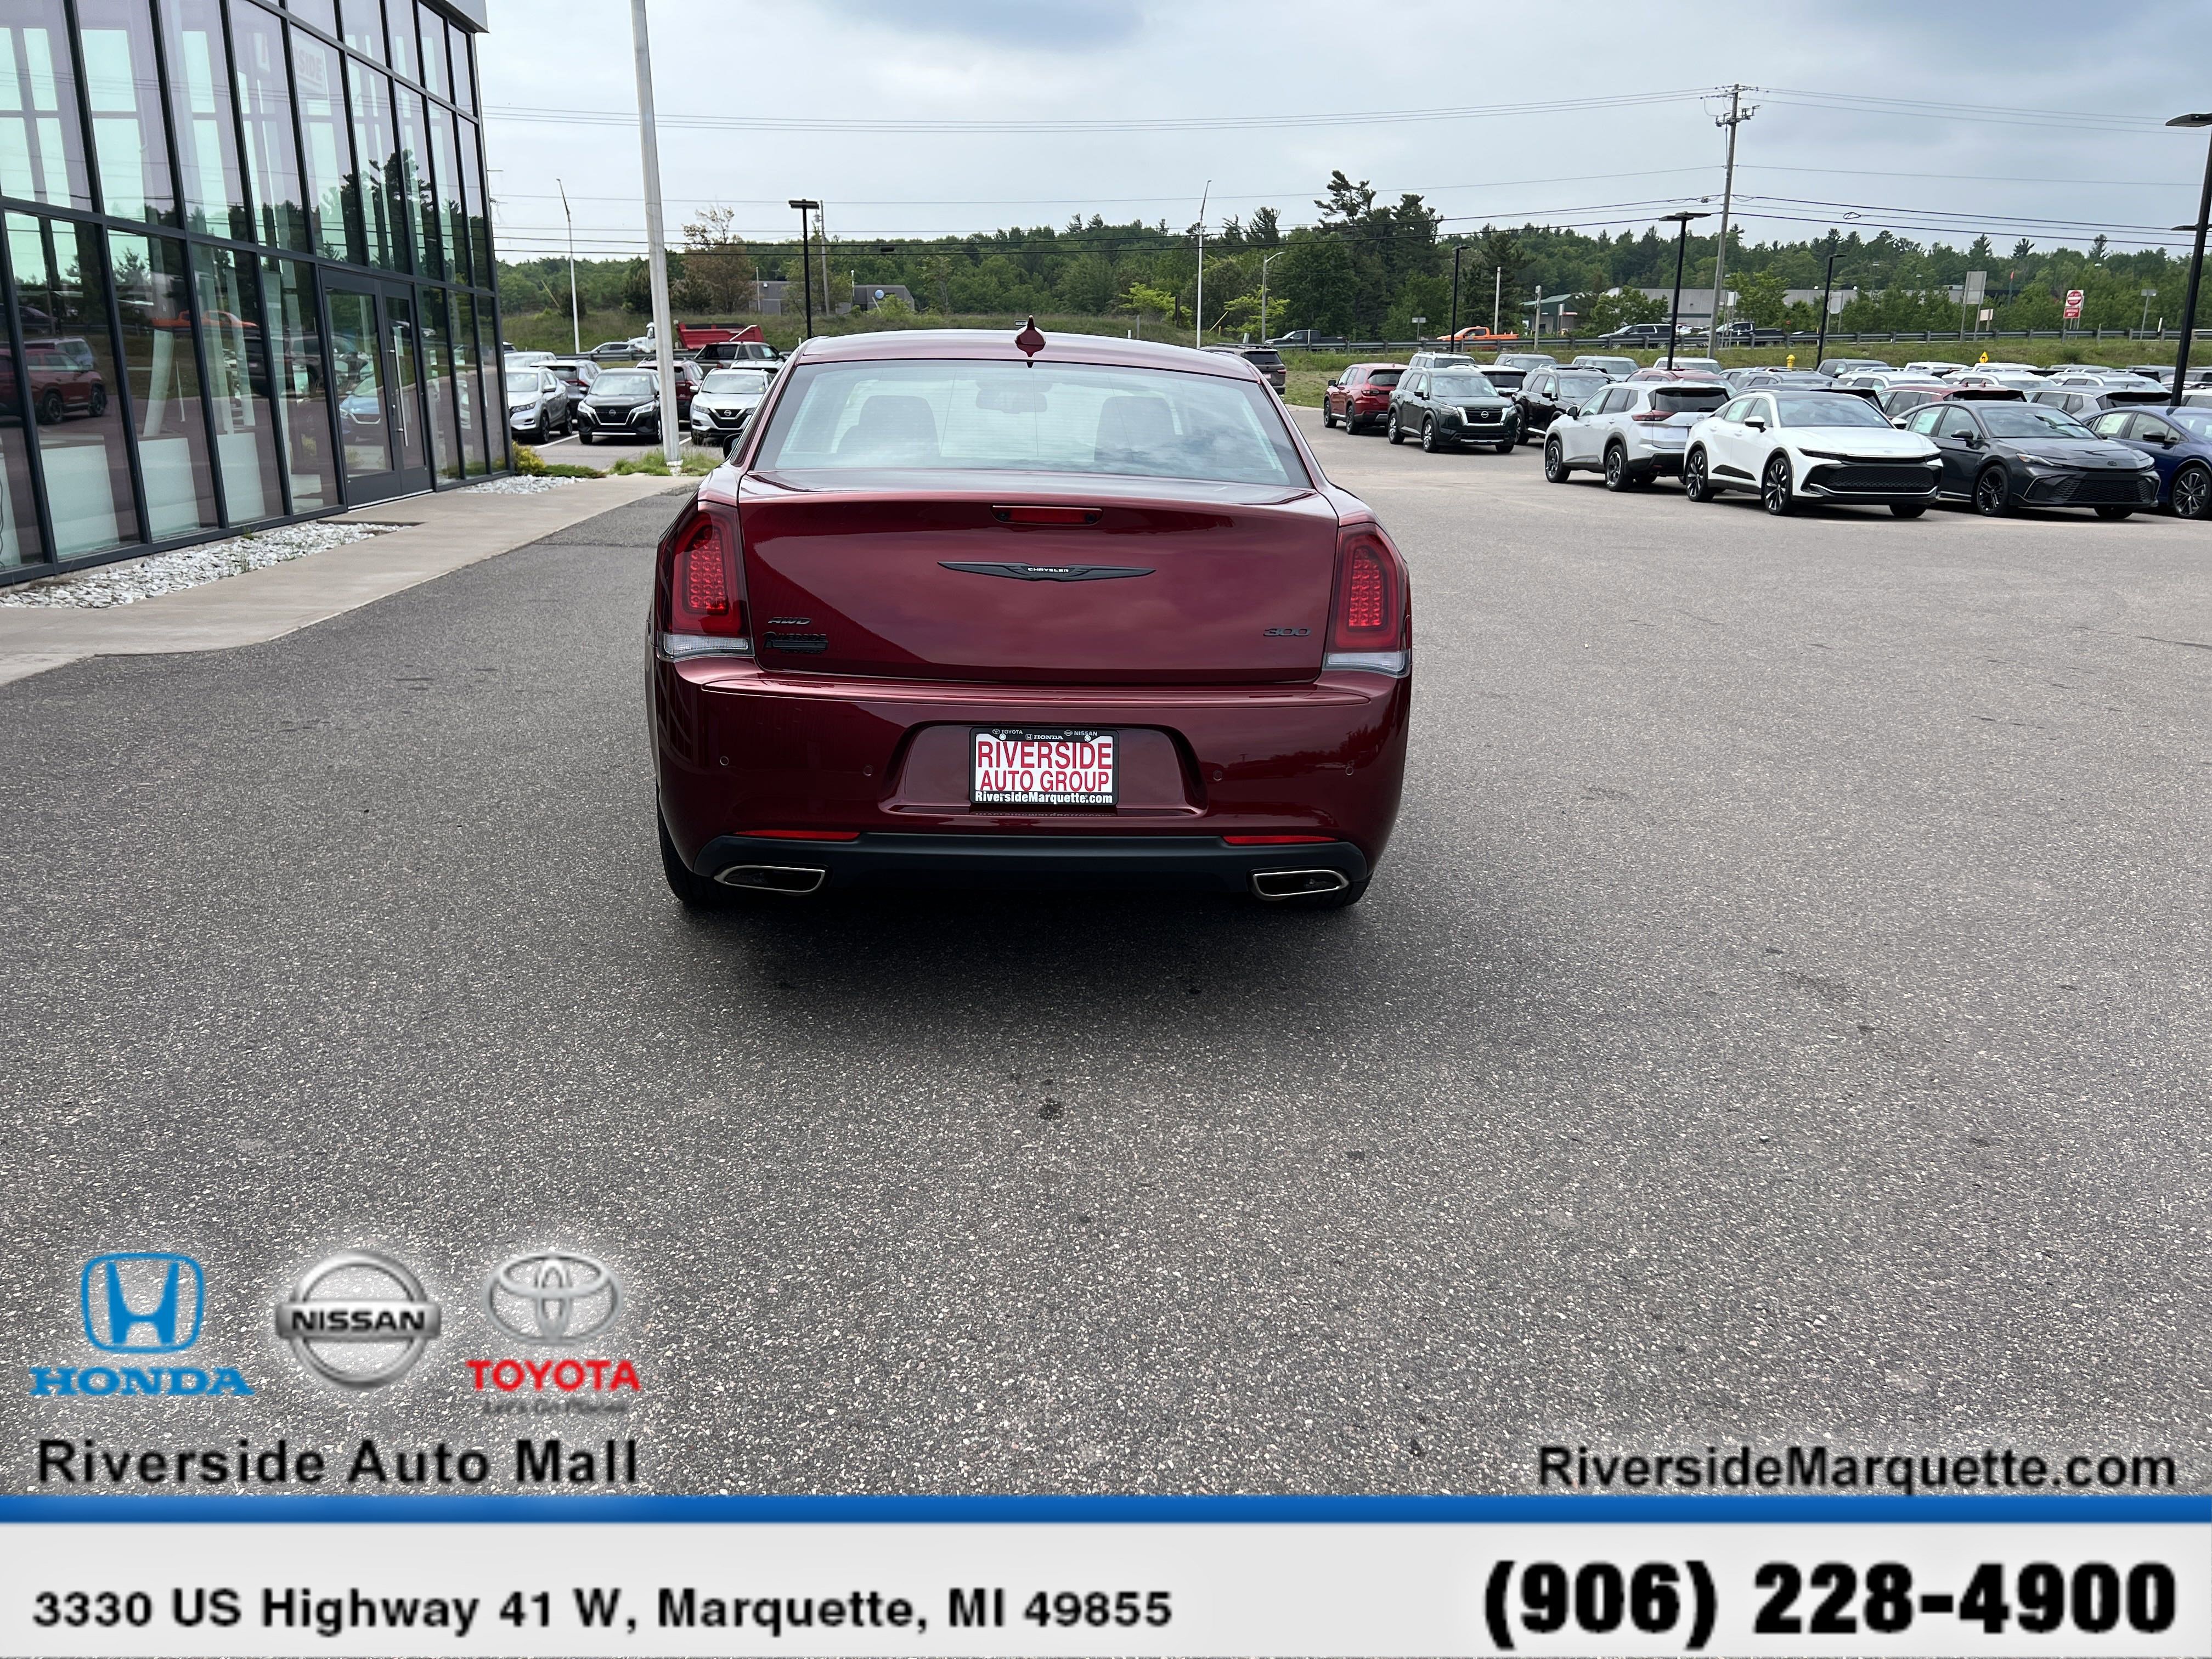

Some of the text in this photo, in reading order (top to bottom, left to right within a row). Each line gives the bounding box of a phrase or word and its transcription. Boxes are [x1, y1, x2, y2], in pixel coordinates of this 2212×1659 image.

[1263, 628, 1311, 636] 300
[978, 741, 1112, 769] RIVERSIDE
[980, 770, 1109, 792] AUTO GROUP
[975, 791, 1113, 805] RiversideMarquette.com
